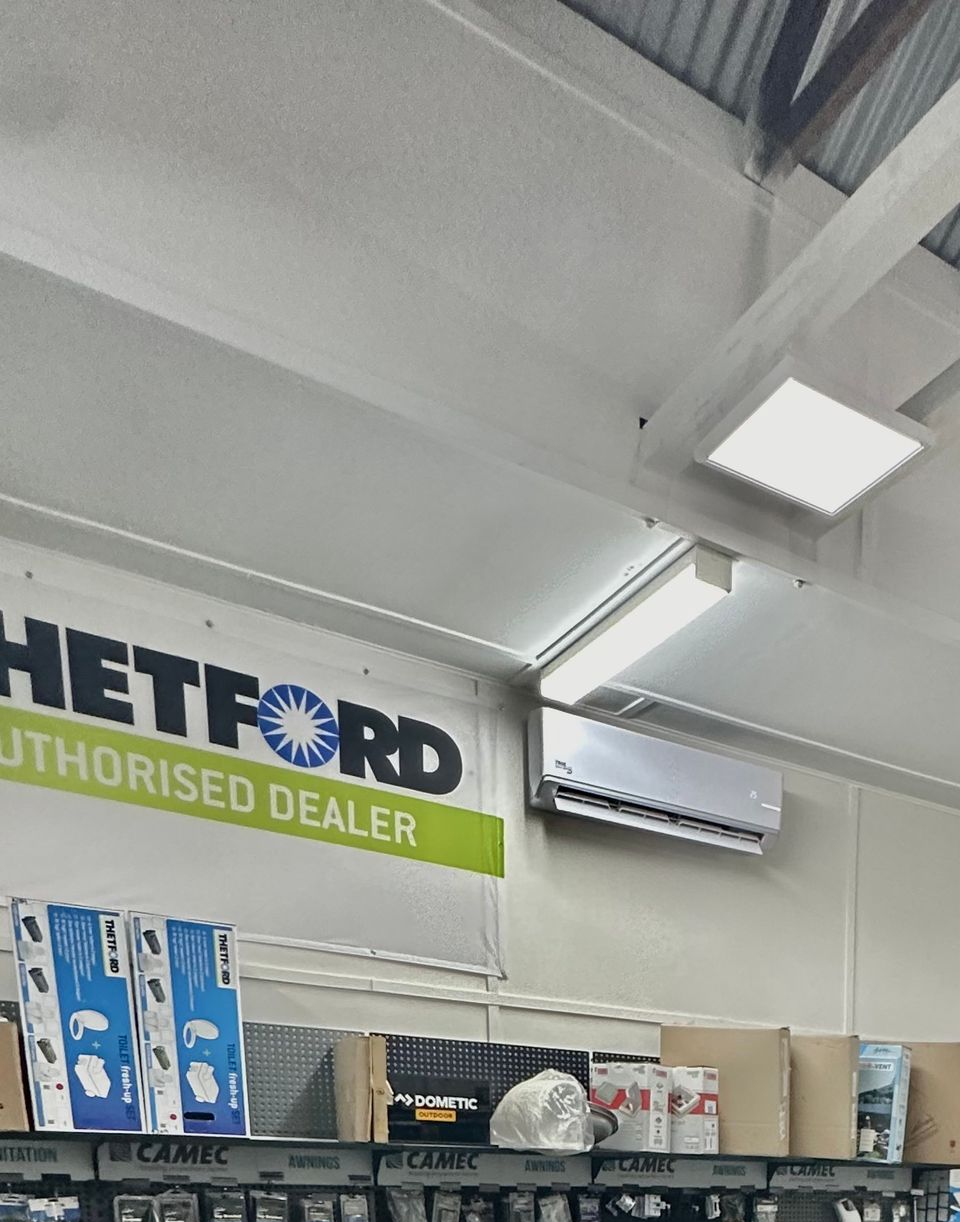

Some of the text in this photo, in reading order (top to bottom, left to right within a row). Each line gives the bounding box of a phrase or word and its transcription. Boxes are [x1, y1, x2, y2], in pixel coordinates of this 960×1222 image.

[270, 784, 417, 847] DEALER
[105, 920, 119, 973] THETFORD
[219, 934, 230, 984] THETFORD
[118, 1035, 129, 1064] TOILET
[121, 1066, 132, 1103] fresh-up
[415, 1094, 478, 1110] DOMETIC
[0, 1147, 57, 1162] ITATION
[136, 1143, 340, 1170] CAMEC AWNINGS
[407, 1151, 480, 1170] CAMEC
[618, 1157, 676, 1173] CAMEC
